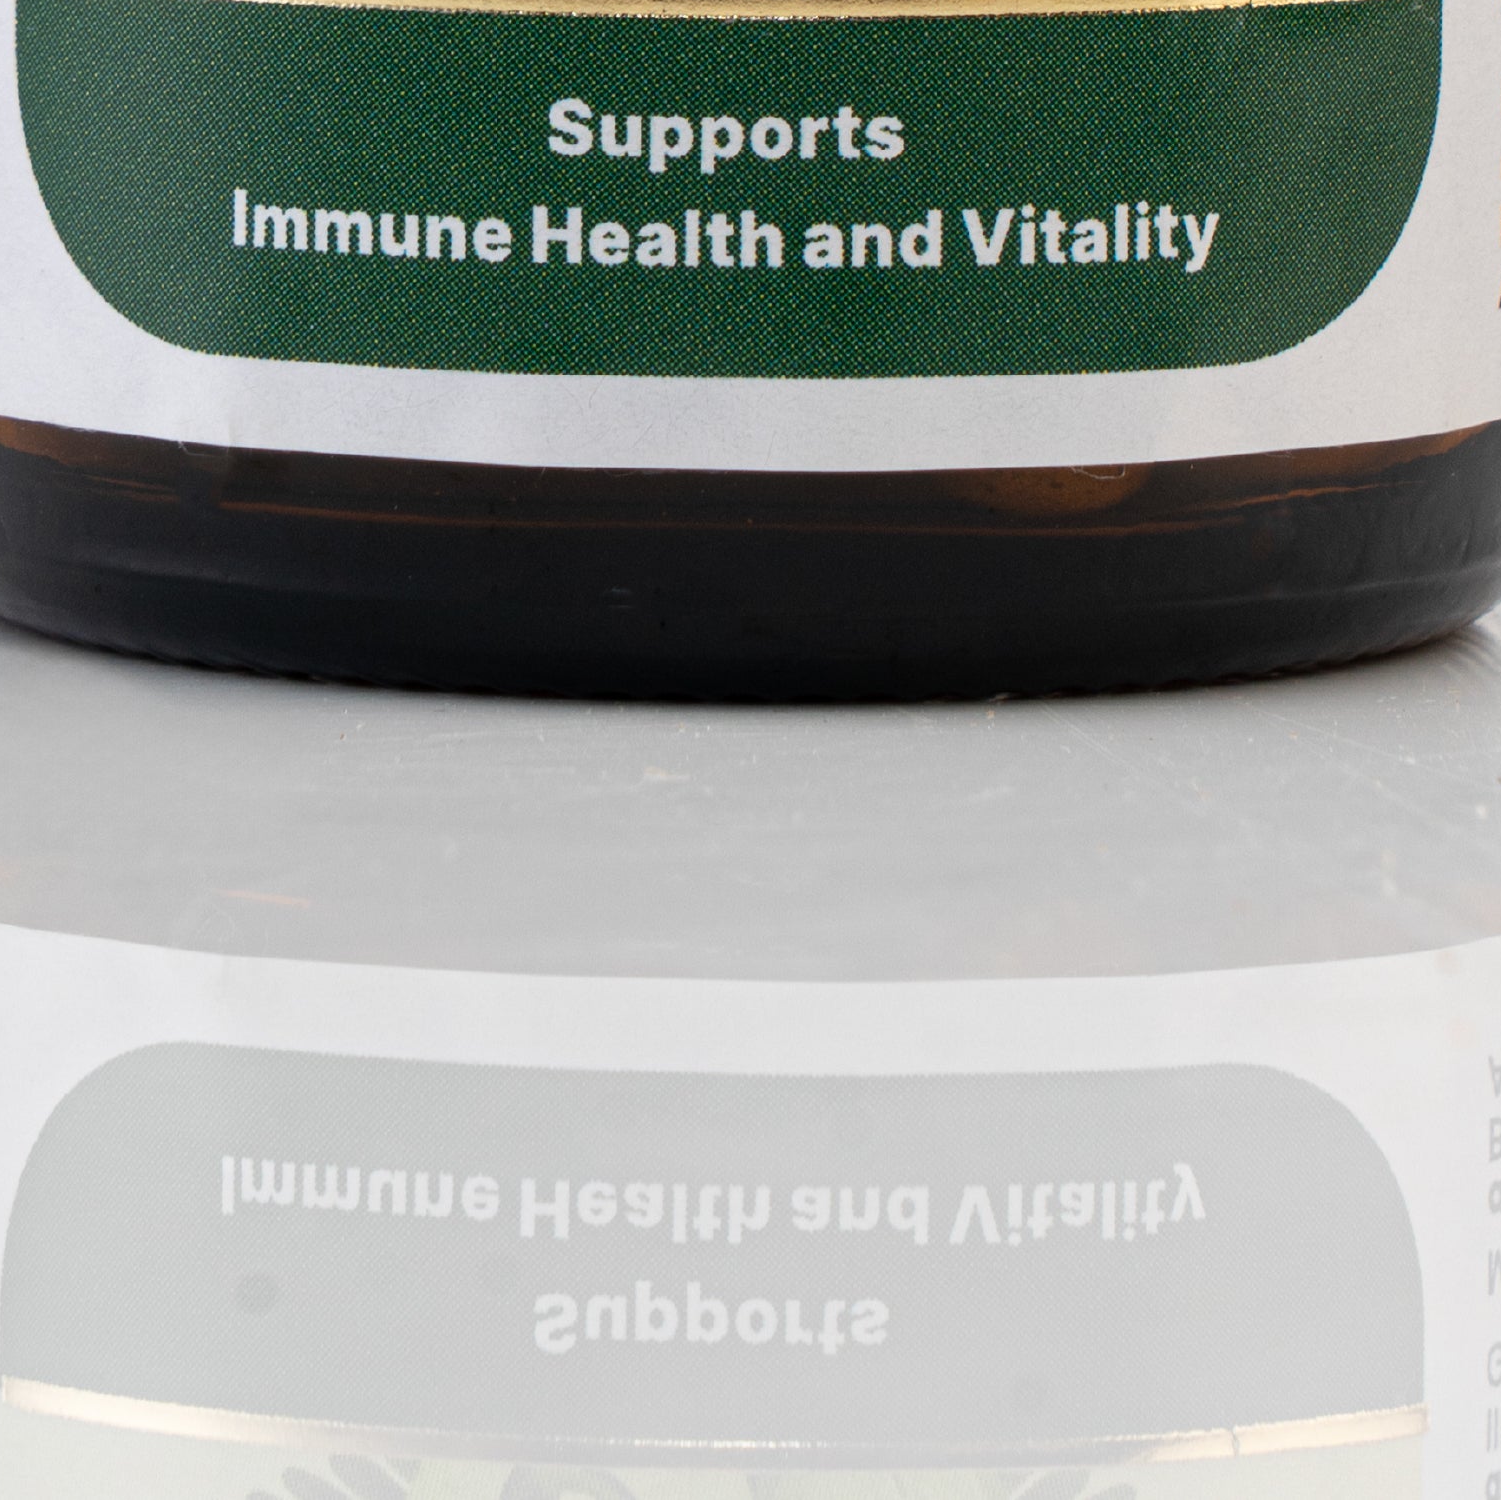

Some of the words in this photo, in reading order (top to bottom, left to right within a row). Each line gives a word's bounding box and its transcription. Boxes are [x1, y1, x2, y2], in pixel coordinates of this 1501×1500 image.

[548, 97, 904, 174] Supports
[233, 189, 512, 263] Immune
[532, 204, 784, 269] Health
[803, 210, 943, 269] and
[962, 202, 1218, 272] Vitality
